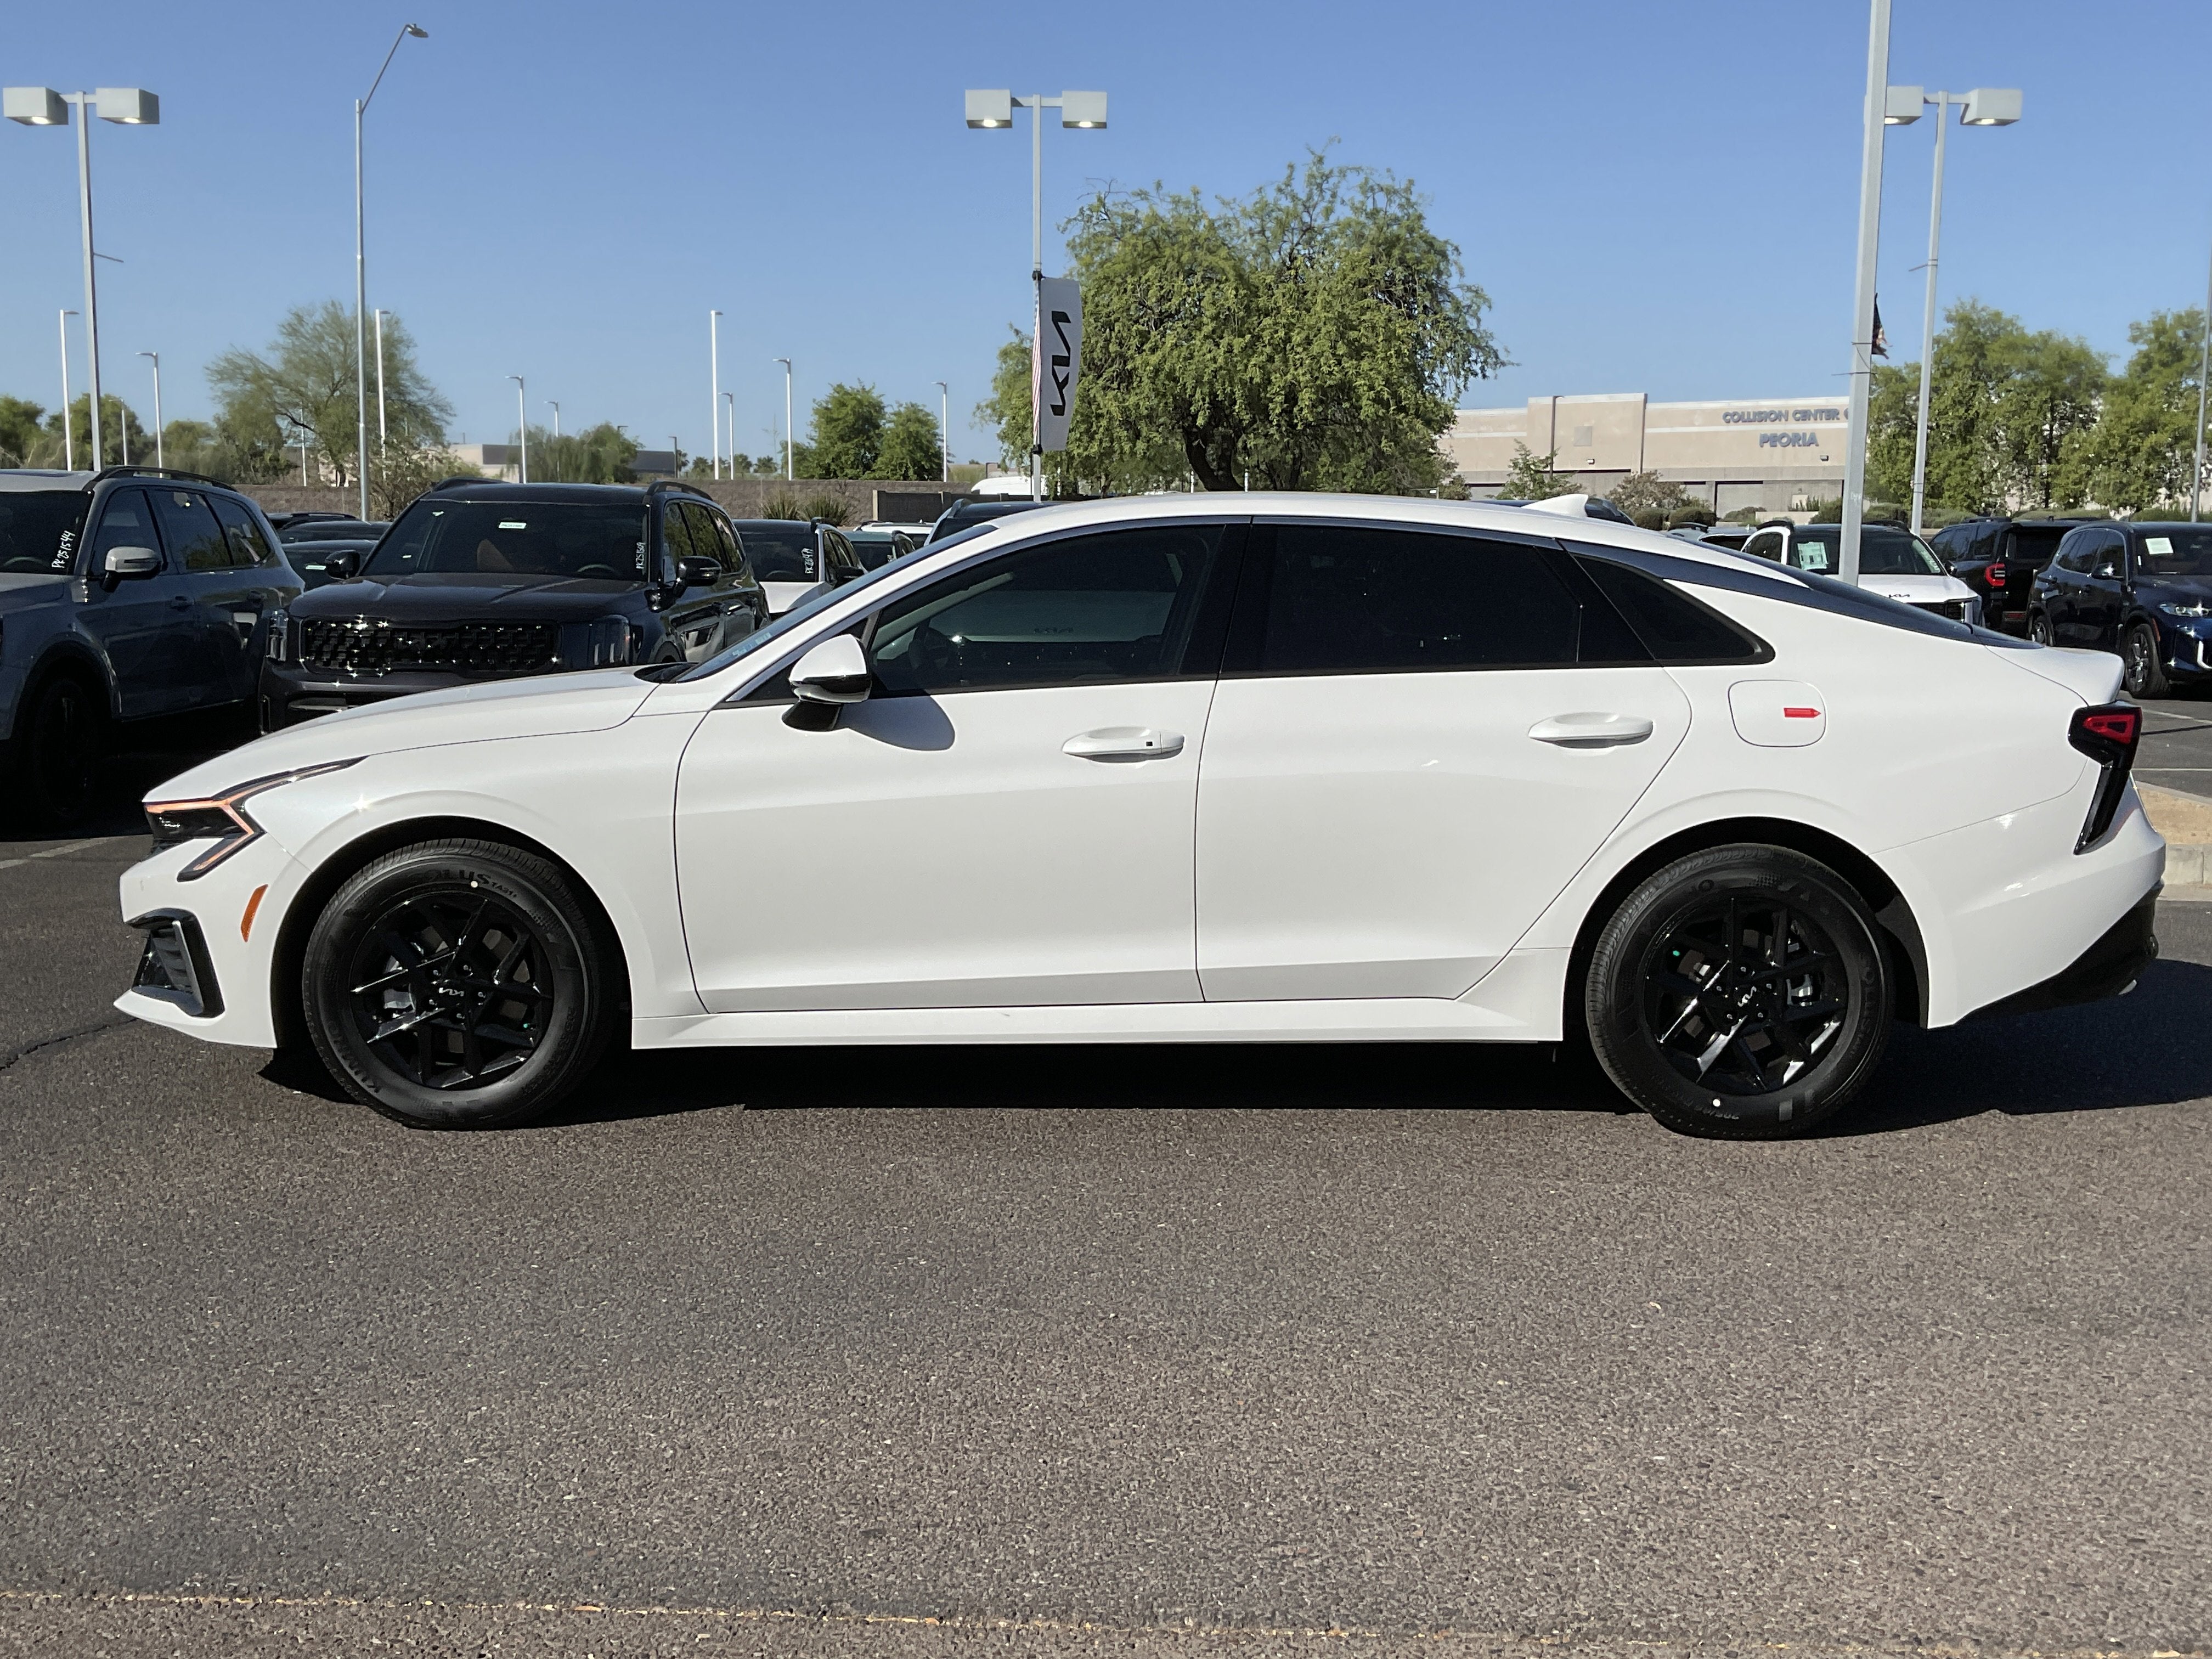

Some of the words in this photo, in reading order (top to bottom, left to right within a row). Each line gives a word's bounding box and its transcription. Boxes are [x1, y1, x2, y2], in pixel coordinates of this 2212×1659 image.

[1050, 311, 1071, 416] KIA
[1722, 410, 1788, 424] COLLISION
[1792, 408, 1840, 421] CENTER
[1759, 432, 1819, 448] PEORIA
